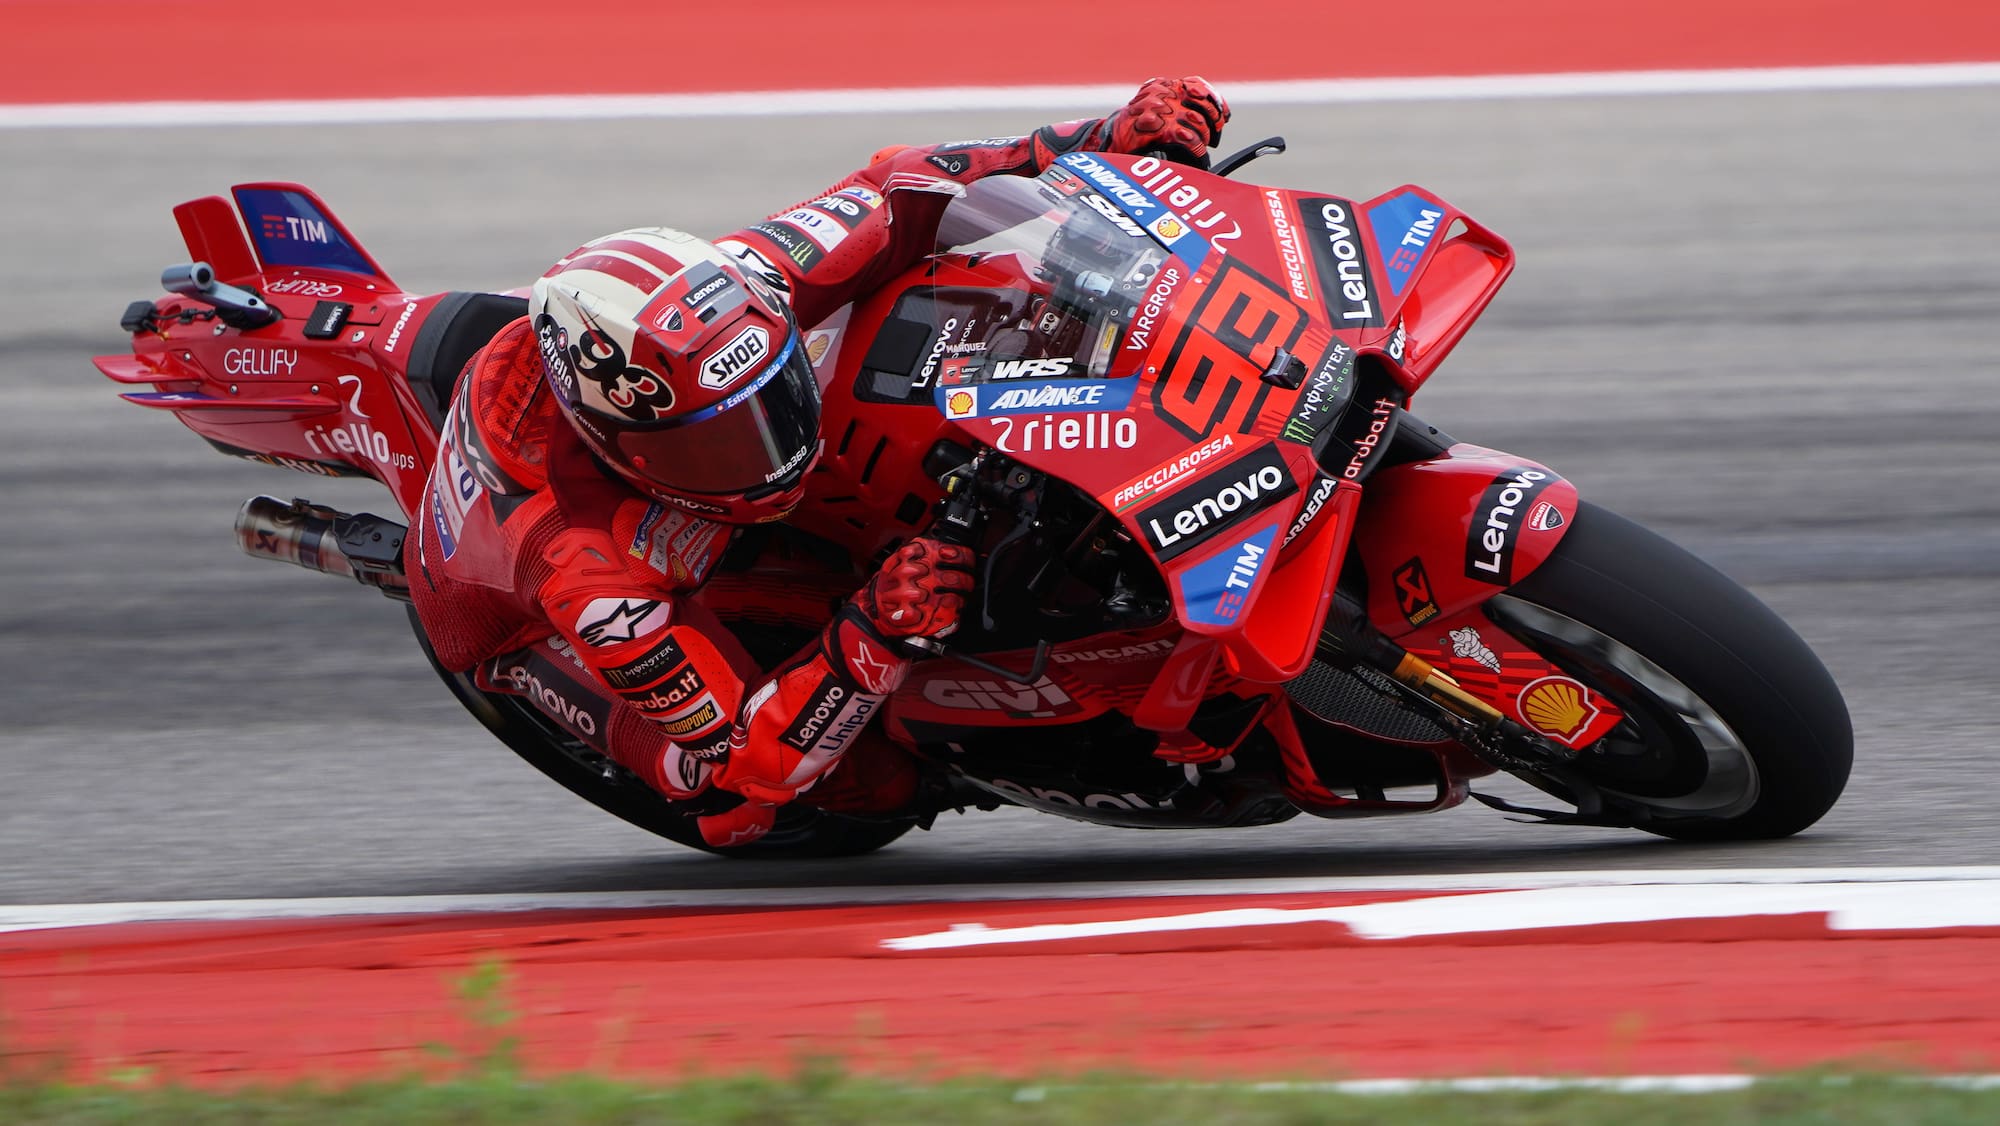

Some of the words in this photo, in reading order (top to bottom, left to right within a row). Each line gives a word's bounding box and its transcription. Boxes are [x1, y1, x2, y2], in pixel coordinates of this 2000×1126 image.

[1063, 153, 1156, 208] ADVANCE
[1130, 156, 1226, 229] riello
[286, 216, 328, 244] TIM
[1079, 194, 1148, 237] WRS
[1401, 209, 1441, 248] TIM
[1269, 190, 1309, 299] FRECCIAROSSA
[1321, 203, 1373, 320] Lenovo
[686, 277, 727, 306] Lenovo
[1127, 268, 1180, 351] VARGROUP
[384, 302, 417, 353] DUCATI
[1151, 255, 1309, 443] 93
[224, 348, 298, 376] GELLIFY
[709, 332, 764, 383] SHOEI
[911, 317, 957, 388] Lenovo
[992, 357, 1074, 380] WRS
[727, 384, 758, 409] Estrella
[757, 363, 781, 386] Galicia
[989, 385, 1106, 410] ADVANCE
[1299, 343, 1350, 420] MONSTER
[1322, 358, 1353, 413] ENERGY
[304, 423, 390, 464] riello
[392, 451, 415, 471] ups
[1023, 413, 1138, 452] riello
[1344, 398, 1397, 480] aruba.it
[765, 446, 807, 483] Insta360
[1114, 434, 1233, 508] FRECCIAROSSA
[651, 488, 724, 513] Lenovo
[1149, 466, 1283, 548] Lenovo
[1474, 470, 1547, 574] Lenovo
[1226, 542, 1265, 590] TIM
[625, 645, 674, 677] MONSTER
[1050, 639, 1176, 663] DUCATI
[630, 671, 699, 709] aruba.it
[922, 675, 1072, 713] GIVI
[788, 686, 844, 748] Lenovo
[819, 695, 877, 757] Unipol
